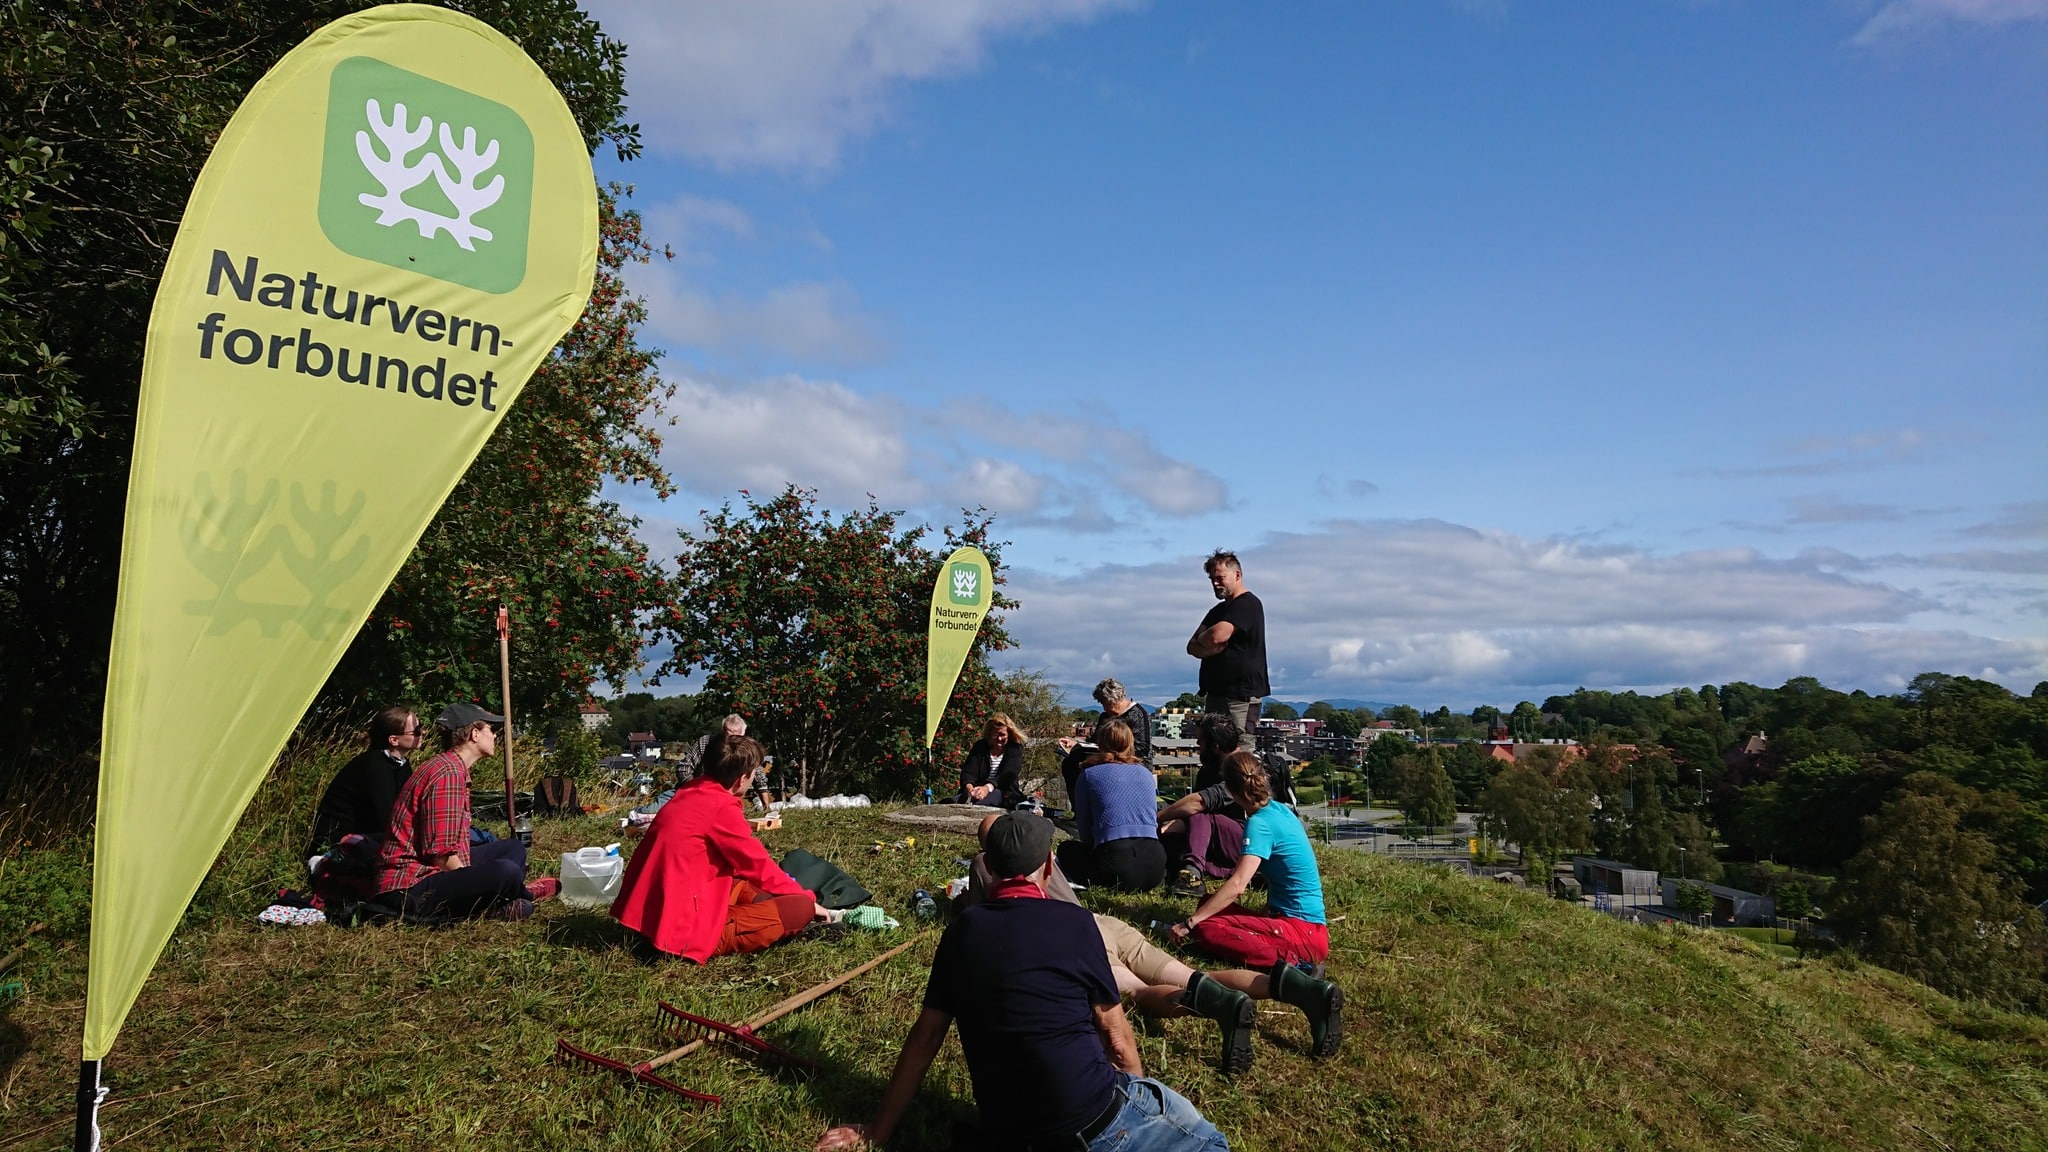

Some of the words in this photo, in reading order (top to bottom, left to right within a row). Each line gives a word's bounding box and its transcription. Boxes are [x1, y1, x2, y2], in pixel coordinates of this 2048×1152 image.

[206, 249, 513, 356] Naturvern-
[197, 312, 498, 412] forbundet
[935, 606, 979, 619] Naturvern-
[935, 618, 977, 631] forbundet
